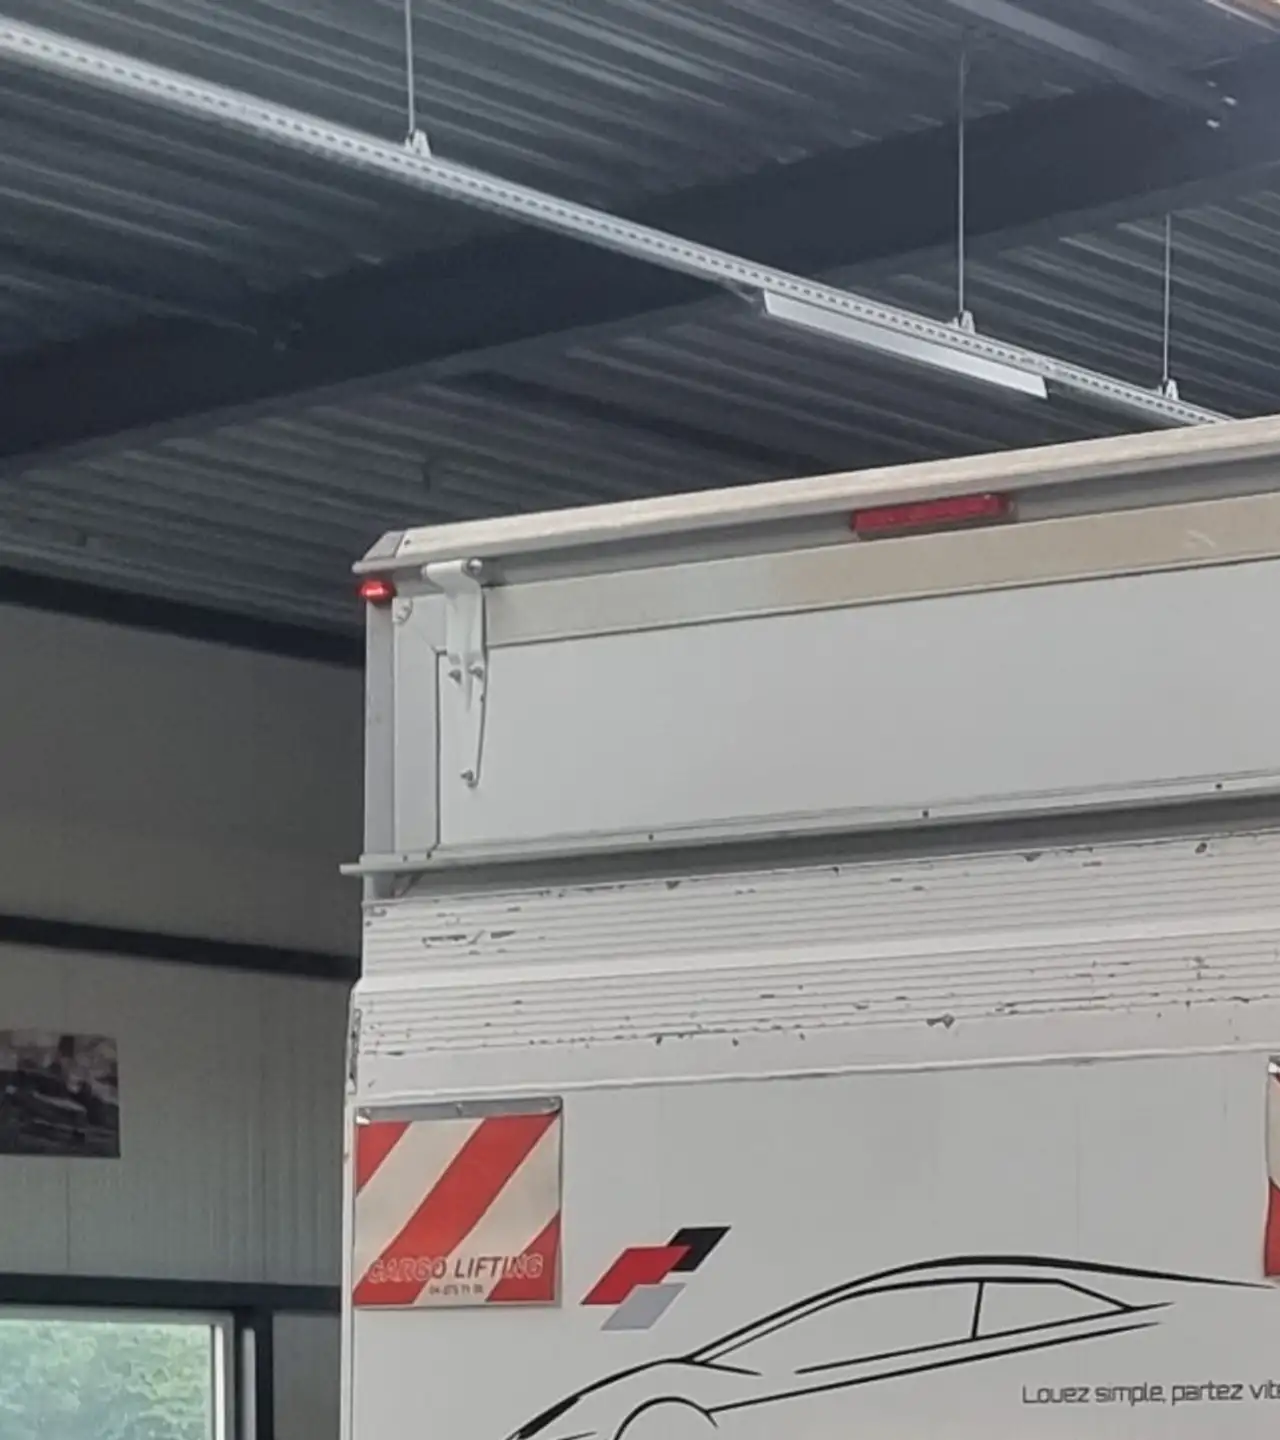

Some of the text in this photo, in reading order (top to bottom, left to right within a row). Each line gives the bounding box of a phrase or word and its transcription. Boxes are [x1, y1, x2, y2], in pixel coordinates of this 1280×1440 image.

[367, 1252, 544, 1284] CARGO LIFTING
[1021, 1384, 1090, 1403] Louez
[1171, 1380, 1243, 1406] partez
